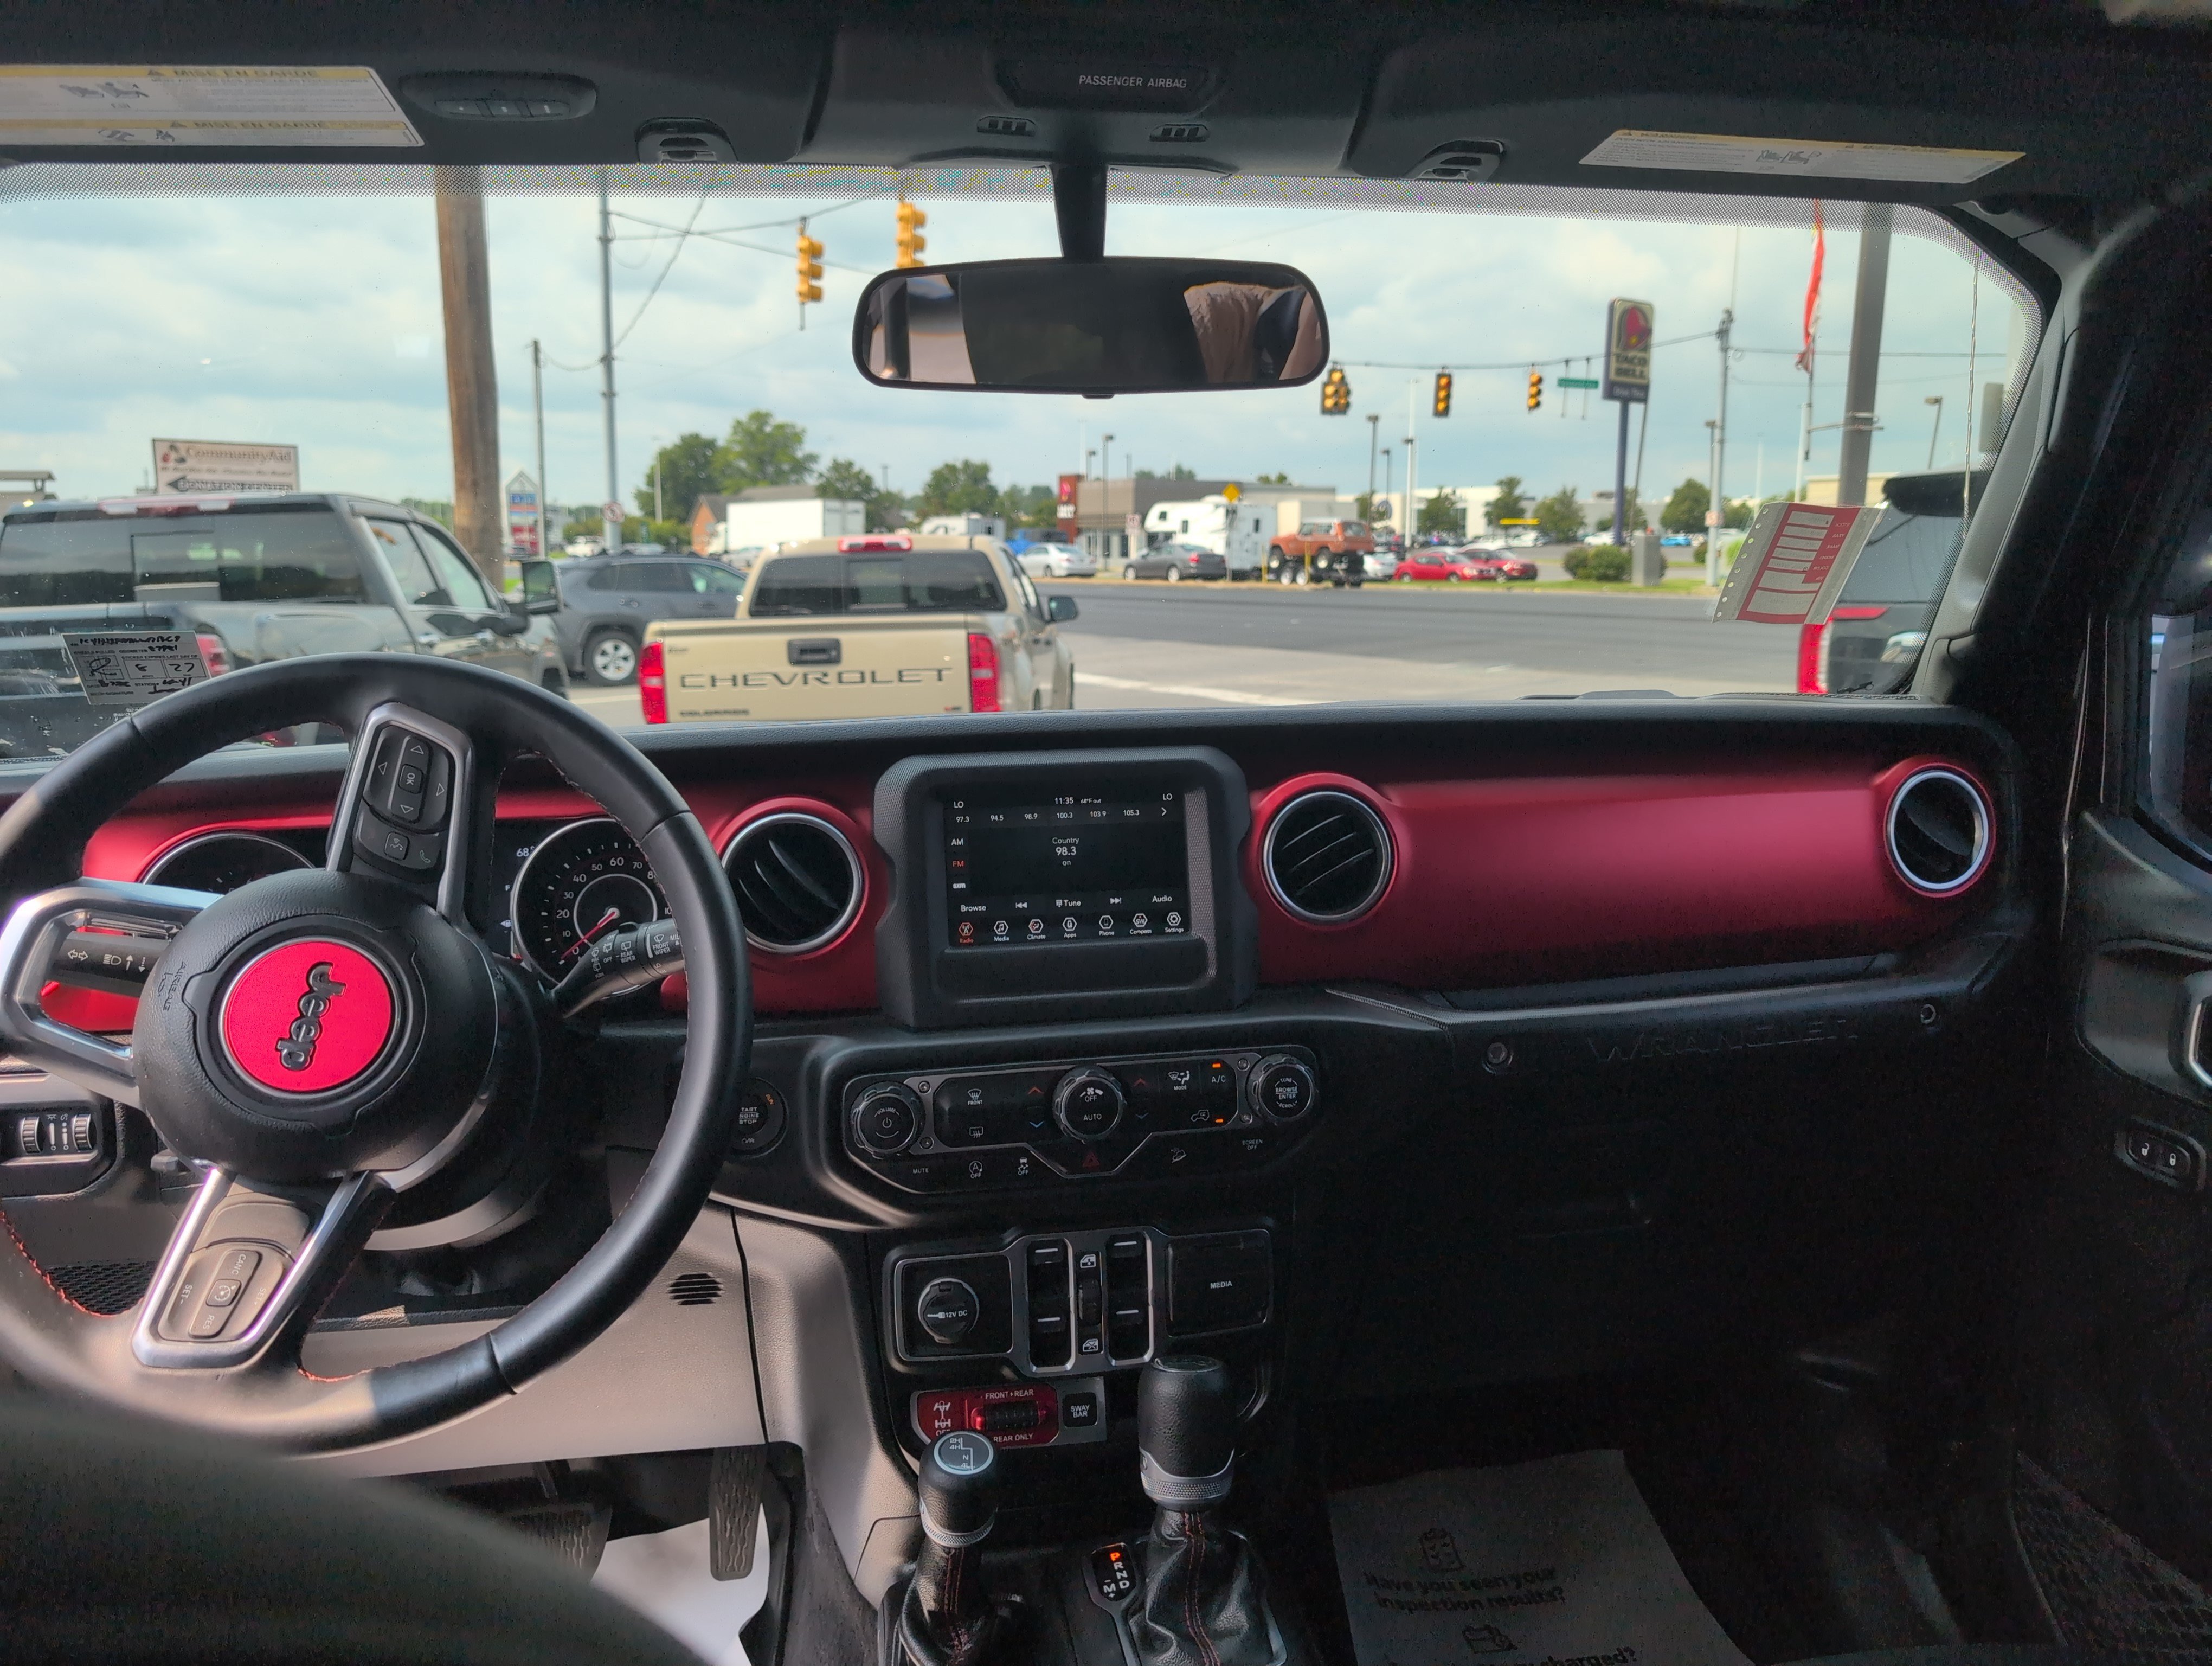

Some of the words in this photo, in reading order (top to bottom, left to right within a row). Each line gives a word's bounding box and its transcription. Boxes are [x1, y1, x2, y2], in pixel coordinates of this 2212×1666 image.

[1079, 75, 1142, 87] PASSENGER
[1148, 78, 1187, 88] AIRBAG
[680, 668, 952, 690] CHEVROLET
[406, 772, 415, 786] OK
[1052, 837, 1079, 845] Country
[1056, 846, 1077, 856] 98.3
[609, 857, 624, 867] 60
[573, 874, 587, 883] 40
[556, 909, 570, 919] 20
[653, 941, 669, 950] FRONT
[572, 947, 580, 955] 0
[654, 947, 671, 956] WIPER
[620, 955, 636, 963] WIPER
[274, 961, 347, 1071] Jeep
[1211, 1074, 1226, 1084] A/C
[1084, 1094, 1098, 1103] OFF
[1083, 1112, 1102, 1122] AUTO
[232, 1254, 247, 1275] CANC
[1210, 1280, 1233, 1290] MEDIA
[182, 1284, 193, 1298] SET
[203, 1315, 215, 1330] RES
[1070, 1404, 1090, 1412] SWAY
[1014, 1433, 1034, 1441] ONLY
[1110, 1552, 1120, 1561] P
[1113, 1561, 1124, 1570] R
[1116, 1570, 1128, 1580] N
[1103, 1583, 1116, 1593] M
[1118, 1580, 1130, 1589] D
